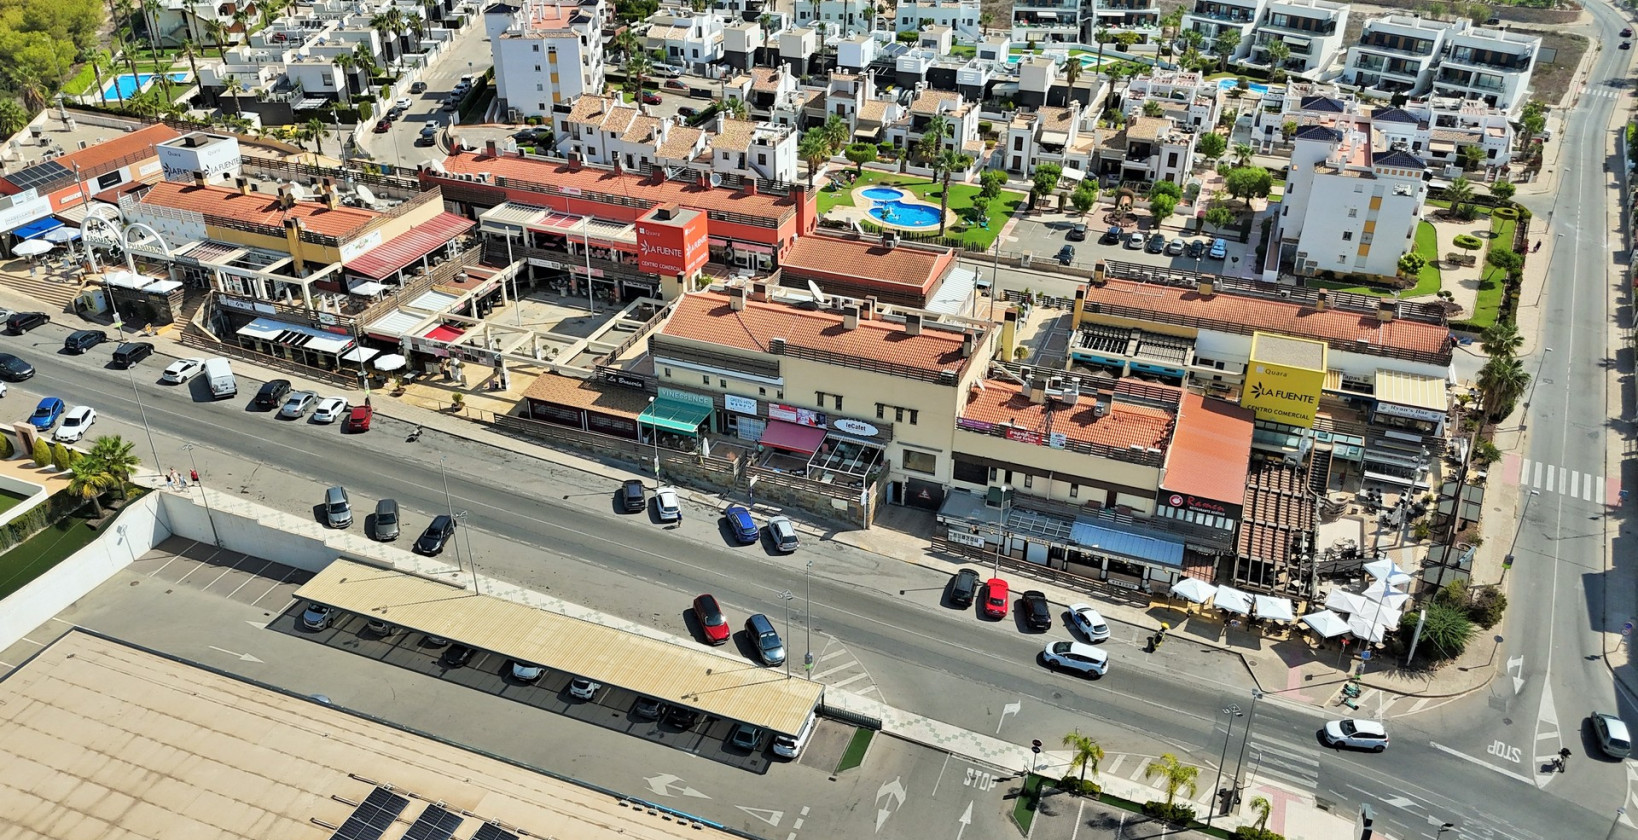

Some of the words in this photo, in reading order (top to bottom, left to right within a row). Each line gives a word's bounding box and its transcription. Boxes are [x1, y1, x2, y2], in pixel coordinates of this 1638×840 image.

[647, 244, 657, 253] LA
[657, 246, 682, 258] FUENTE
[641, 260, 659, 268] CENTRO
[1265, 368, 1288, 378] Quara
[661, 389, 709, 405] VINESSENCE
[1261, 387, 1274, 398] LA
[1275, 389, 1315, 404] FUENTE
[1247, 404, 1273, 415] CENTRO
[1273, 408, 1310, 421] COMERCIAL
[1187, 496, 1225, 511] Ramen
[1487, 740, 1522, 763] STOP
[963, 767, 1000, 792] STOP
